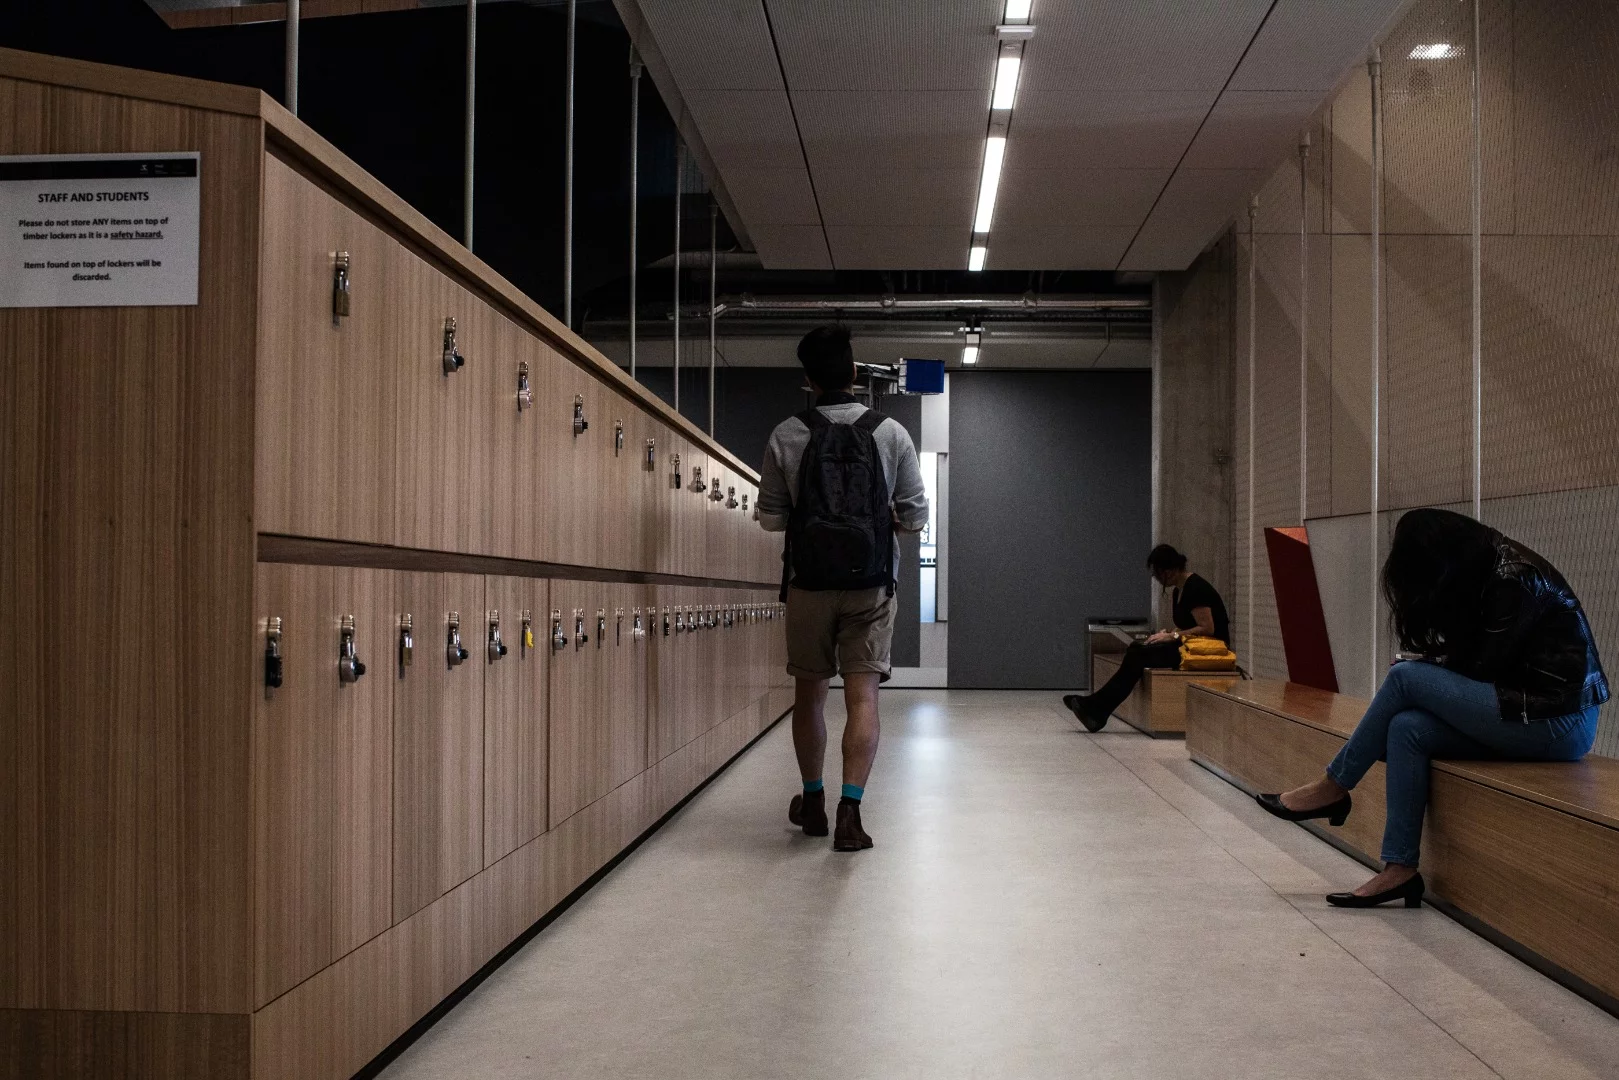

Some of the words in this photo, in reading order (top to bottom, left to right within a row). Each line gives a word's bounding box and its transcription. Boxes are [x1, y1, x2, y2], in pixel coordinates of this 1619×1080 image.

[38, 193, 68, 203] STAFF
[70, 193, 94, 202] AND
[96, 192, 149, 202] STUDENTS
[19, 219, 43, 227] Please
[145, 218, 159, 227] top
[160, 217, 169, 225] of
[23, 232, 48, 240] timber
[88, 231, 94, 239] it
[95, 231, 102, 239] is
[110, 231, 134, 240] safety
[135, 230, 163, 239] hazard.
[82, 261, 96, 269] top
[97, 260, 106, 268] of
[136, 259, 150, 267] will
[72, 273, 111, 281] discarded.
